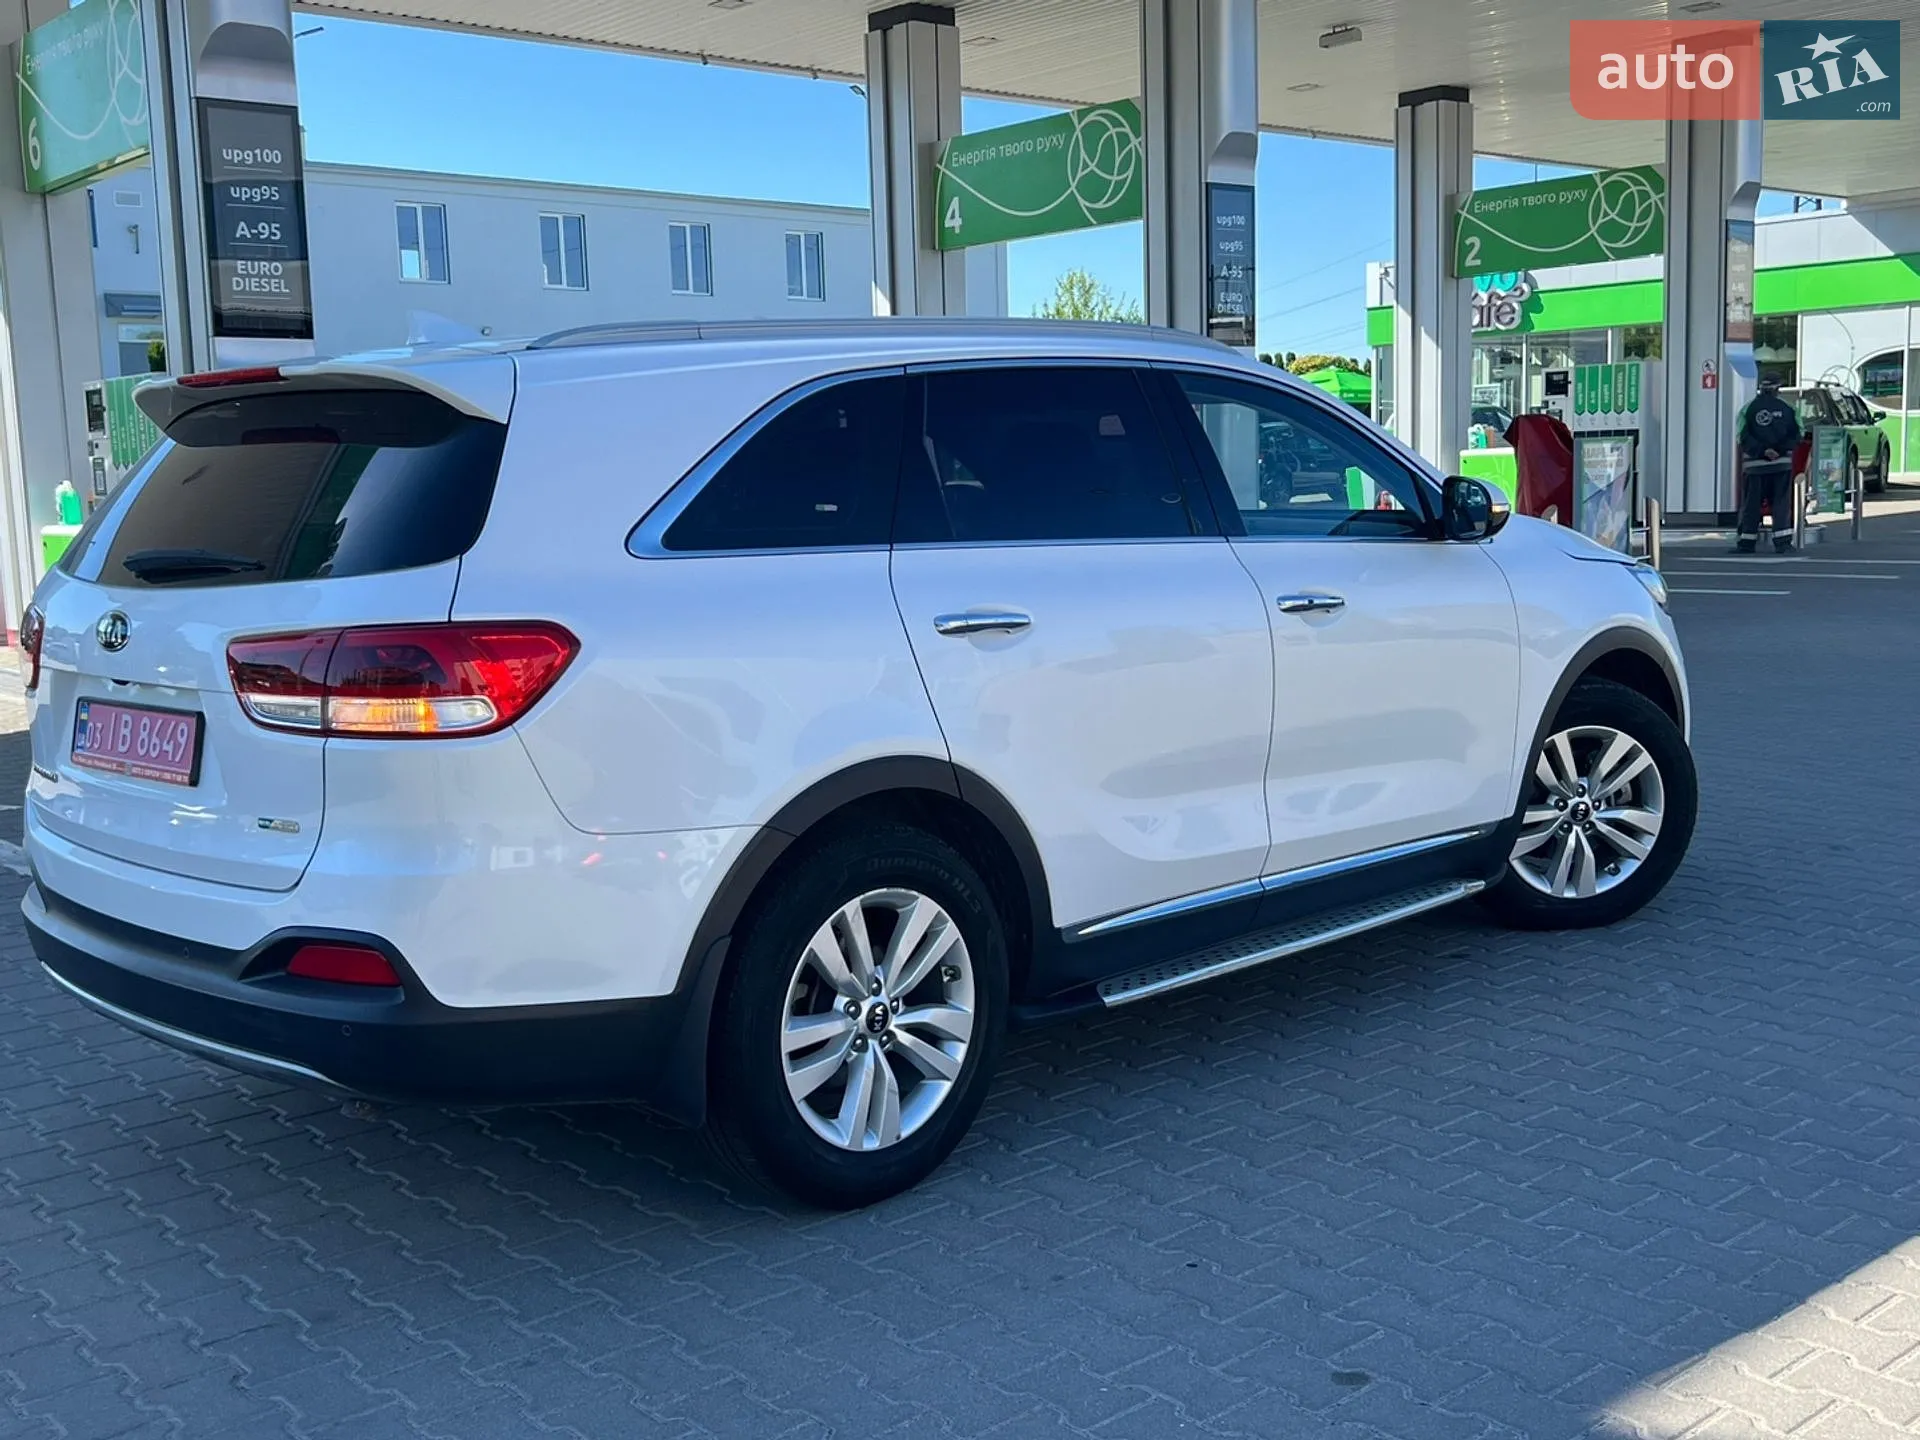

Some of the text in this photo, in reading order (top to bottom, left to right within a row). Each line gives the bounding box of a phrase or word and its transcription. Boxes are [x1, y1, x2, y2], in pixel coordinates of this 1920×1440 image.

[28, 118, 41, 171] 6
[951, 133, 1066, 167] Енергія твого руху
[222, 147, 282, 164] upg100
[230, 185, 280, 202] upg95
[1474, 189, 1588, 214] Енергія твого руху
[944, 196, 962, 234] 4
[1216, 215, 1246, 227] upg100
[235, 221, 281, 240] A-95
[1219, 241, 1244, 252] upg95
[1464, 236, 1482, 267] 2
[236, 260, 283, 276] EURO
[232, 277, 290, 292] DIESEL
[1220, 292, 1243, 302] EURO
[1217, 303, 1245, 314] DIESEL
[86, 721, 104, 749] 03
[136, 715, 189, 762] 8649
